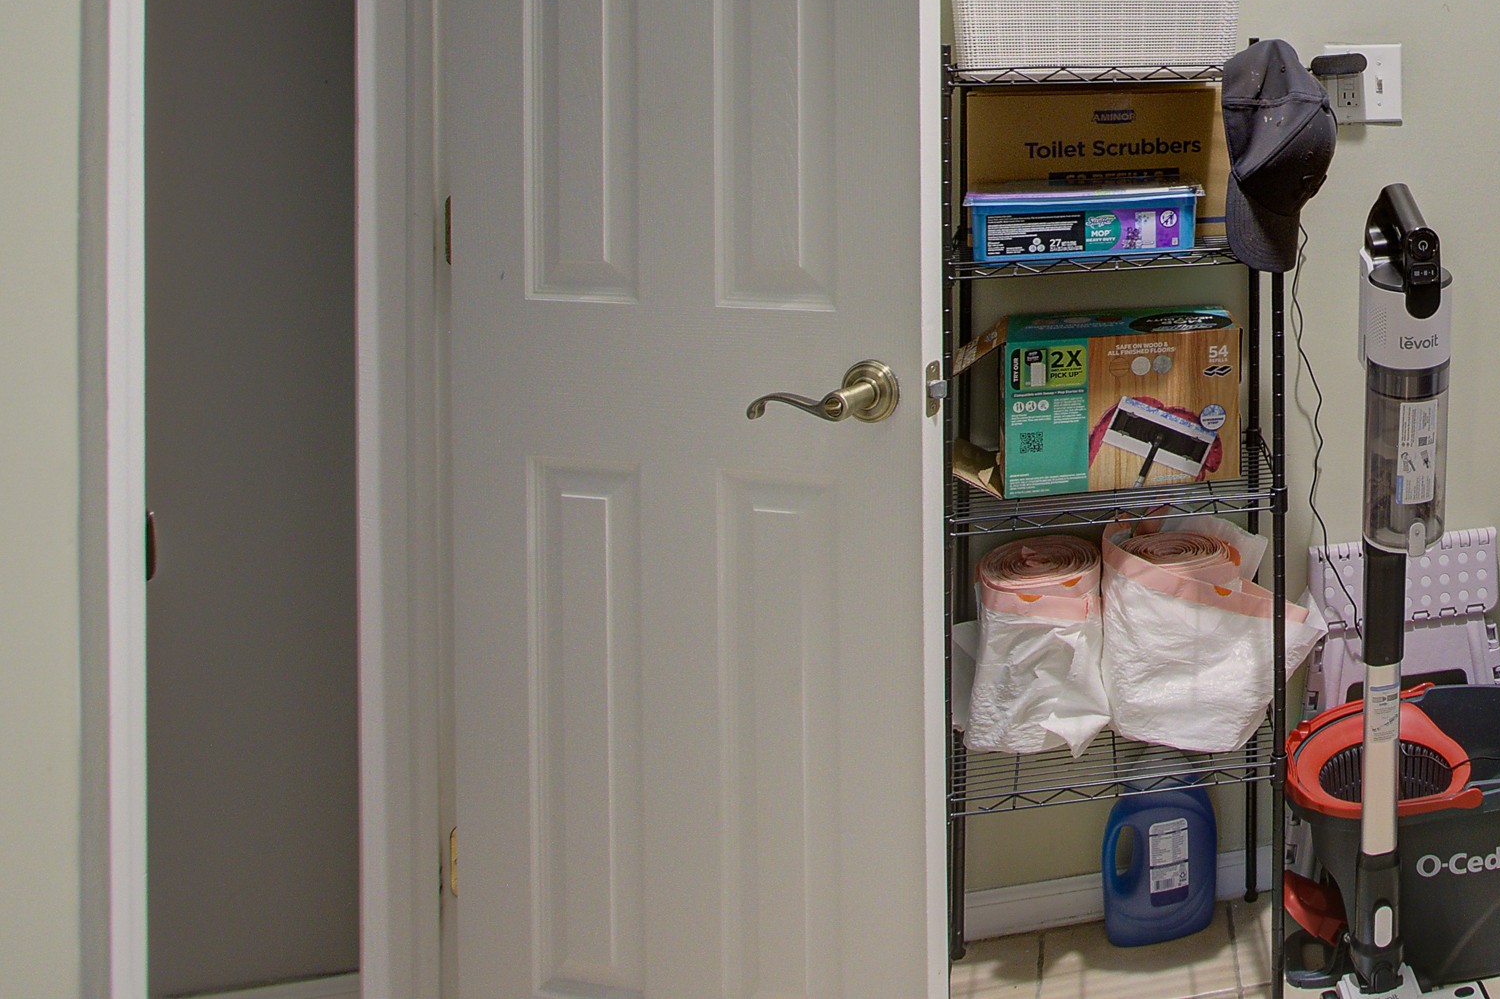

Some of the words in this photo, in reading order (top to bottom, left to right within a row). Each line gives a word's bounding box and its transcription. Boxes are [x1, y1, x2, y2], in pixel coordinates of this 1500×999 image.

[1025, 141, 1086, 159] Toilet
[1093, 137, 1202, 157] Scrubbers
[1049, 239, 1061, 247] 27
[1050, 350, 1082, 368] 2X
[1208, 345, 1229, 358] 54
